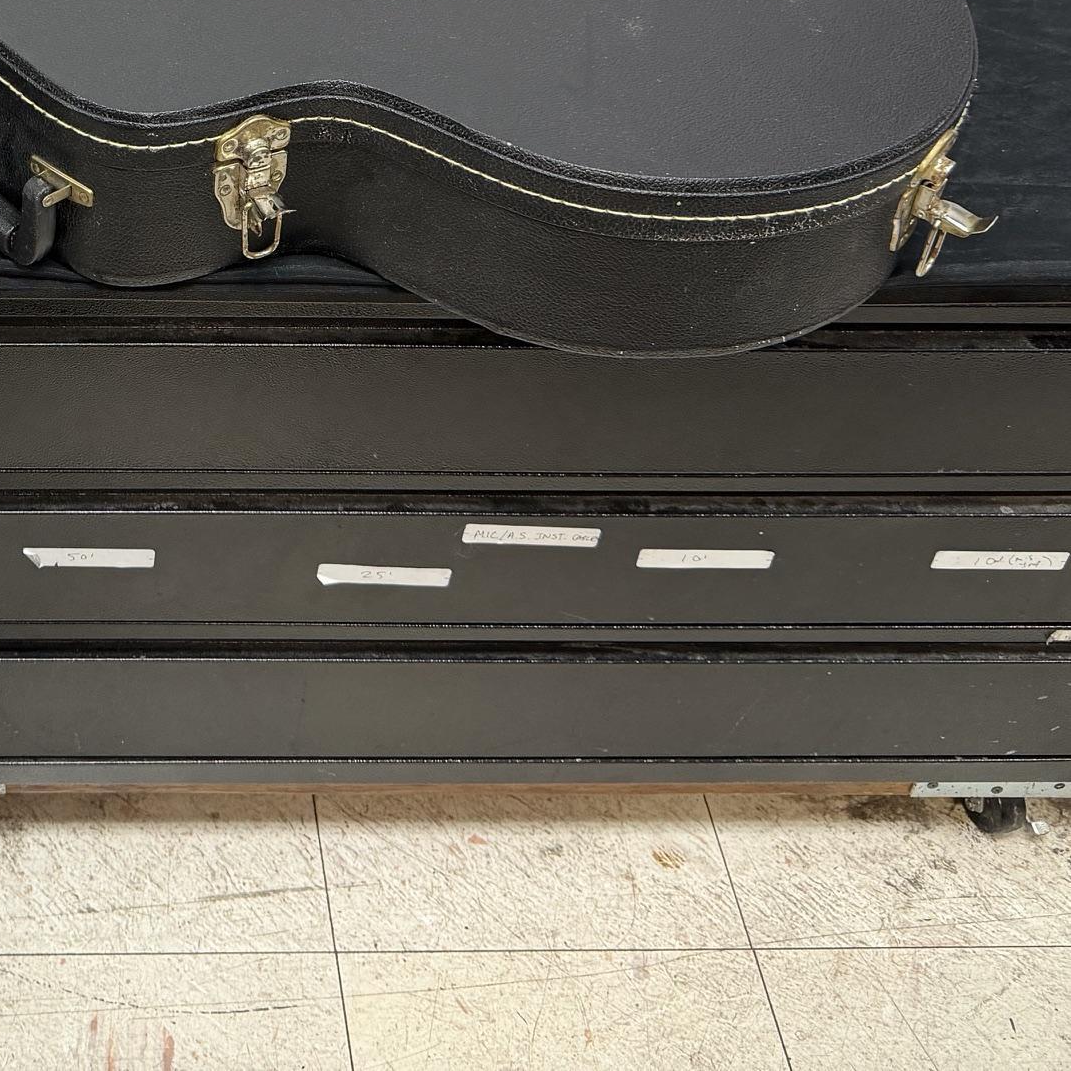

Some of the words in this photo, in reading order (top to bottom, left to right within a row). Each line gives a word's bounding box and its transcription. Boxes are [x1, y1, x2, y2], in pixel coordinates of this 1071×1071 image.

[67, 552, 95, 562] 50'
[681, 553, 707, 563] 10'
[360, 570, 393, 580] 25'
